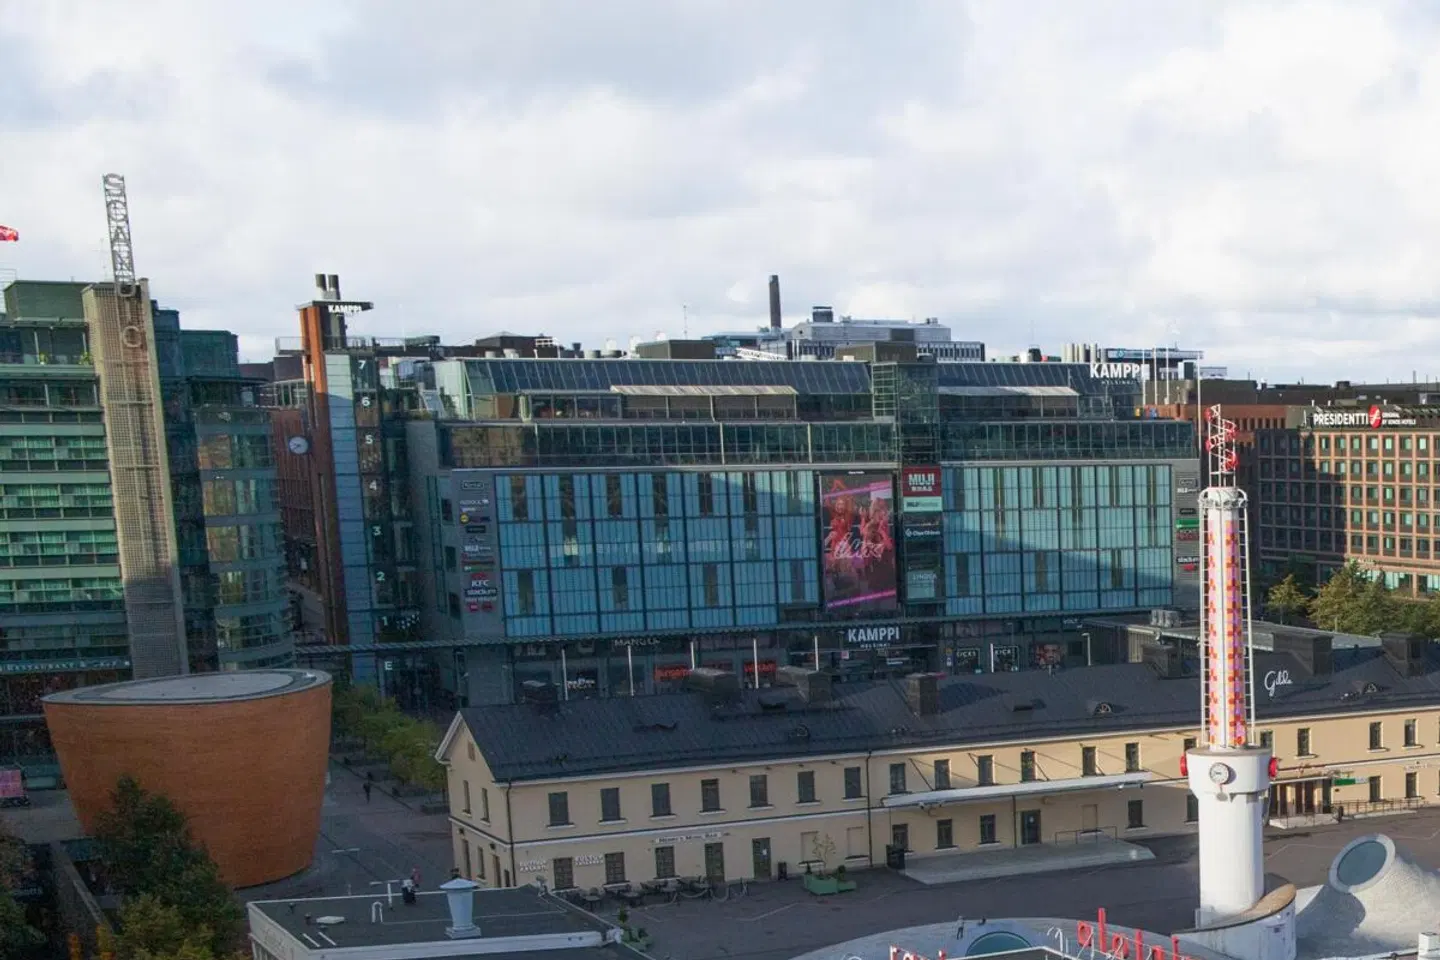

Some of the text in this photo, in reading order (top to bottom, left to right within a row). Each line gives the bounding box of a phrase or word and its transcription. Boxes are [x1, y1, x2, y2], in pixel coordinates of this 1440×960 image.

[104, 173, 142, 348] SCANDIC
[328, 305, 362, 314] KAMPPI
[358, 360, 366, 370] 7
[362, 396, 370, 406] 6
[1313, 412, 1368, 425] PRESIDENTTI
[365, 434, 373, 444] 5
[908, 473, 935, 486] MUJI
[369, 480, 377, 490] 4
[372, 526, 381, 535] 3
[377, 571, 385, 580] 2
[381, 616, 388, 625] 1
[848, 626, 900, 643] KAMPPI
[385, 661, 393, 670] E
